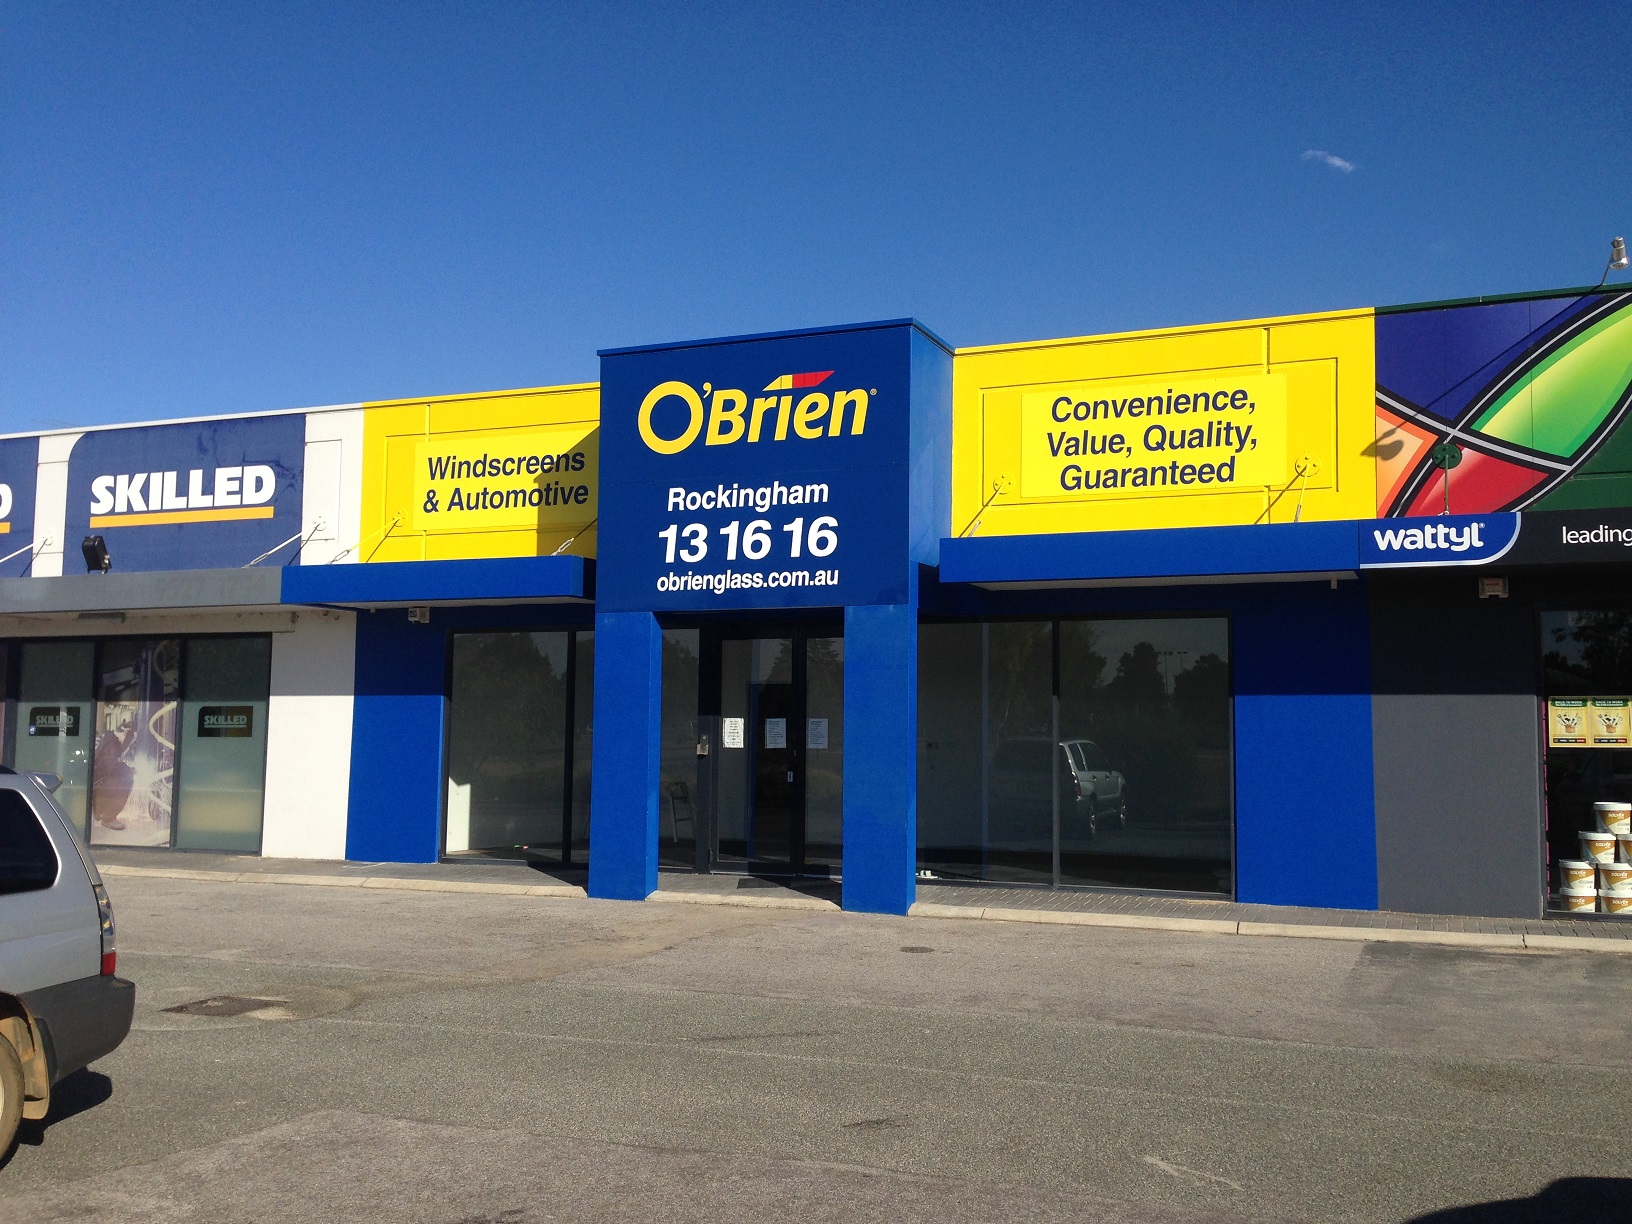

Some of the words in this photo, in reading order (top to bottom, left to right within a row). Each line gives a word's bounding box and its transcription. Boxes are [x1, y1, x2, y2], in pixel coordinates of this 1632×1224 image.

[637, 380, 870, 455] O'Brien
[1051, 388, 1256, 423] Convenience,
[1047, 429, 1132, 458] Value,
[1143, 420, 1258, 453] Quality,
[427, 451, 586, 481] Windscreens
[1060, 455, 1236, 492] Guaranteed
[89, 464, 276, 515] SKILLED
[422, 489, 440, 514] &
[446, 480, 589, 512] Automotive
[667, 480, 829, 513] Rockingham
[657, 523, 709, 564] 13
[719, 519, 772, 561] 16
[782, 516, 839, 558] 16
[1373, 522, 1485, 552] wattyl
[1562, 524, 1632, 547] leading
[656, 568, 839, 595] obrienglass.com.au
[35, 715, 74, 725] SKILLD
[203, 715, 248, 725] SKILLED
